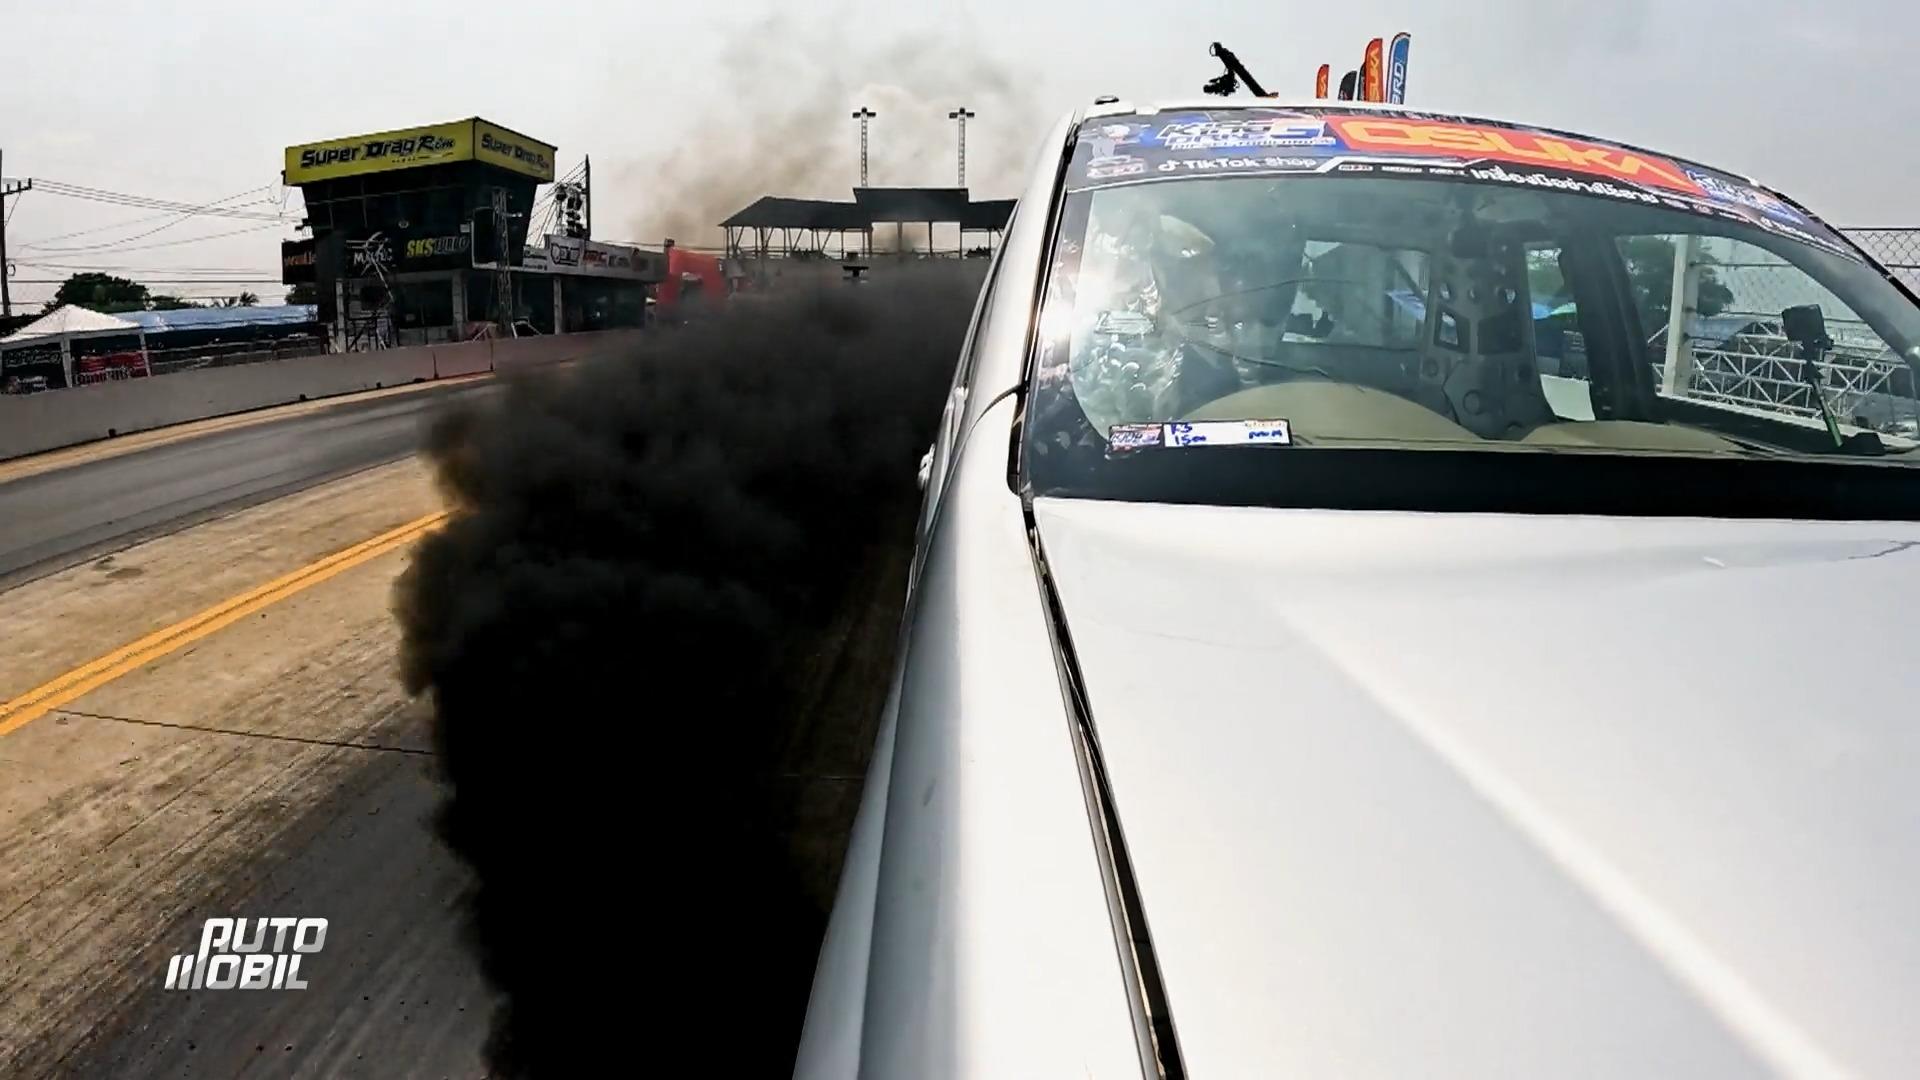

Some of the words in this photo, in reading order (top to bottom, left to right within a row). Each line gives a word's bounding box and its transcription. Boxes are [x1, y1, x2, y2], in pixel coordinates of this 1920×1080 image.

[302, 147, 360, 168] Super
[361, 138, 415, 158] Drag
[1181, 156, 1259, 170] TikTok
[1264, 156, 1317, 170] Shop
[1341, 120, 1703, 196] OSUKA
